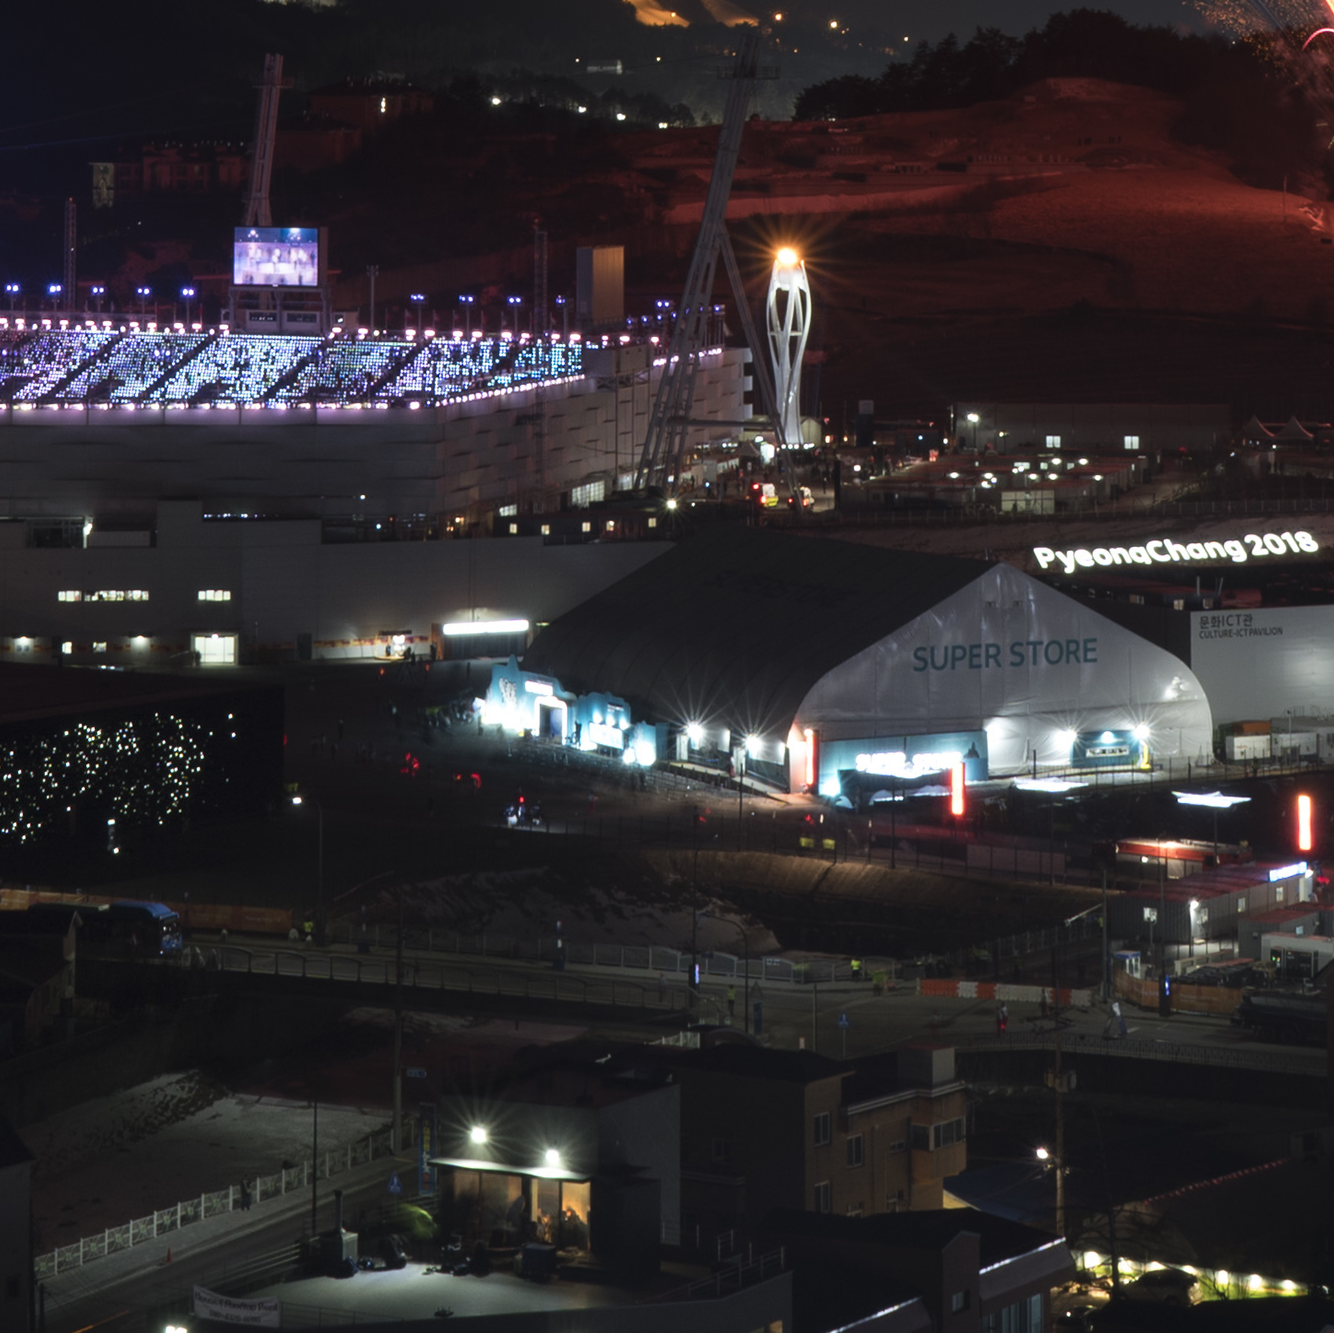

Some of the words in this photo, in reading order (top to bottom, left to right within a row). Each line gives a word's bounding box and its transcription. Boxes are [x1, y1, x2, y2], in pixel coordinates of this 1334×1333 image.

[1033, 538, 1248, 574] PyeongChang
[1243, 531, 1319, 556] 2018
[913, 643, 1002, 673] SUPER
[1009, 637, 1099, 667] STORE
